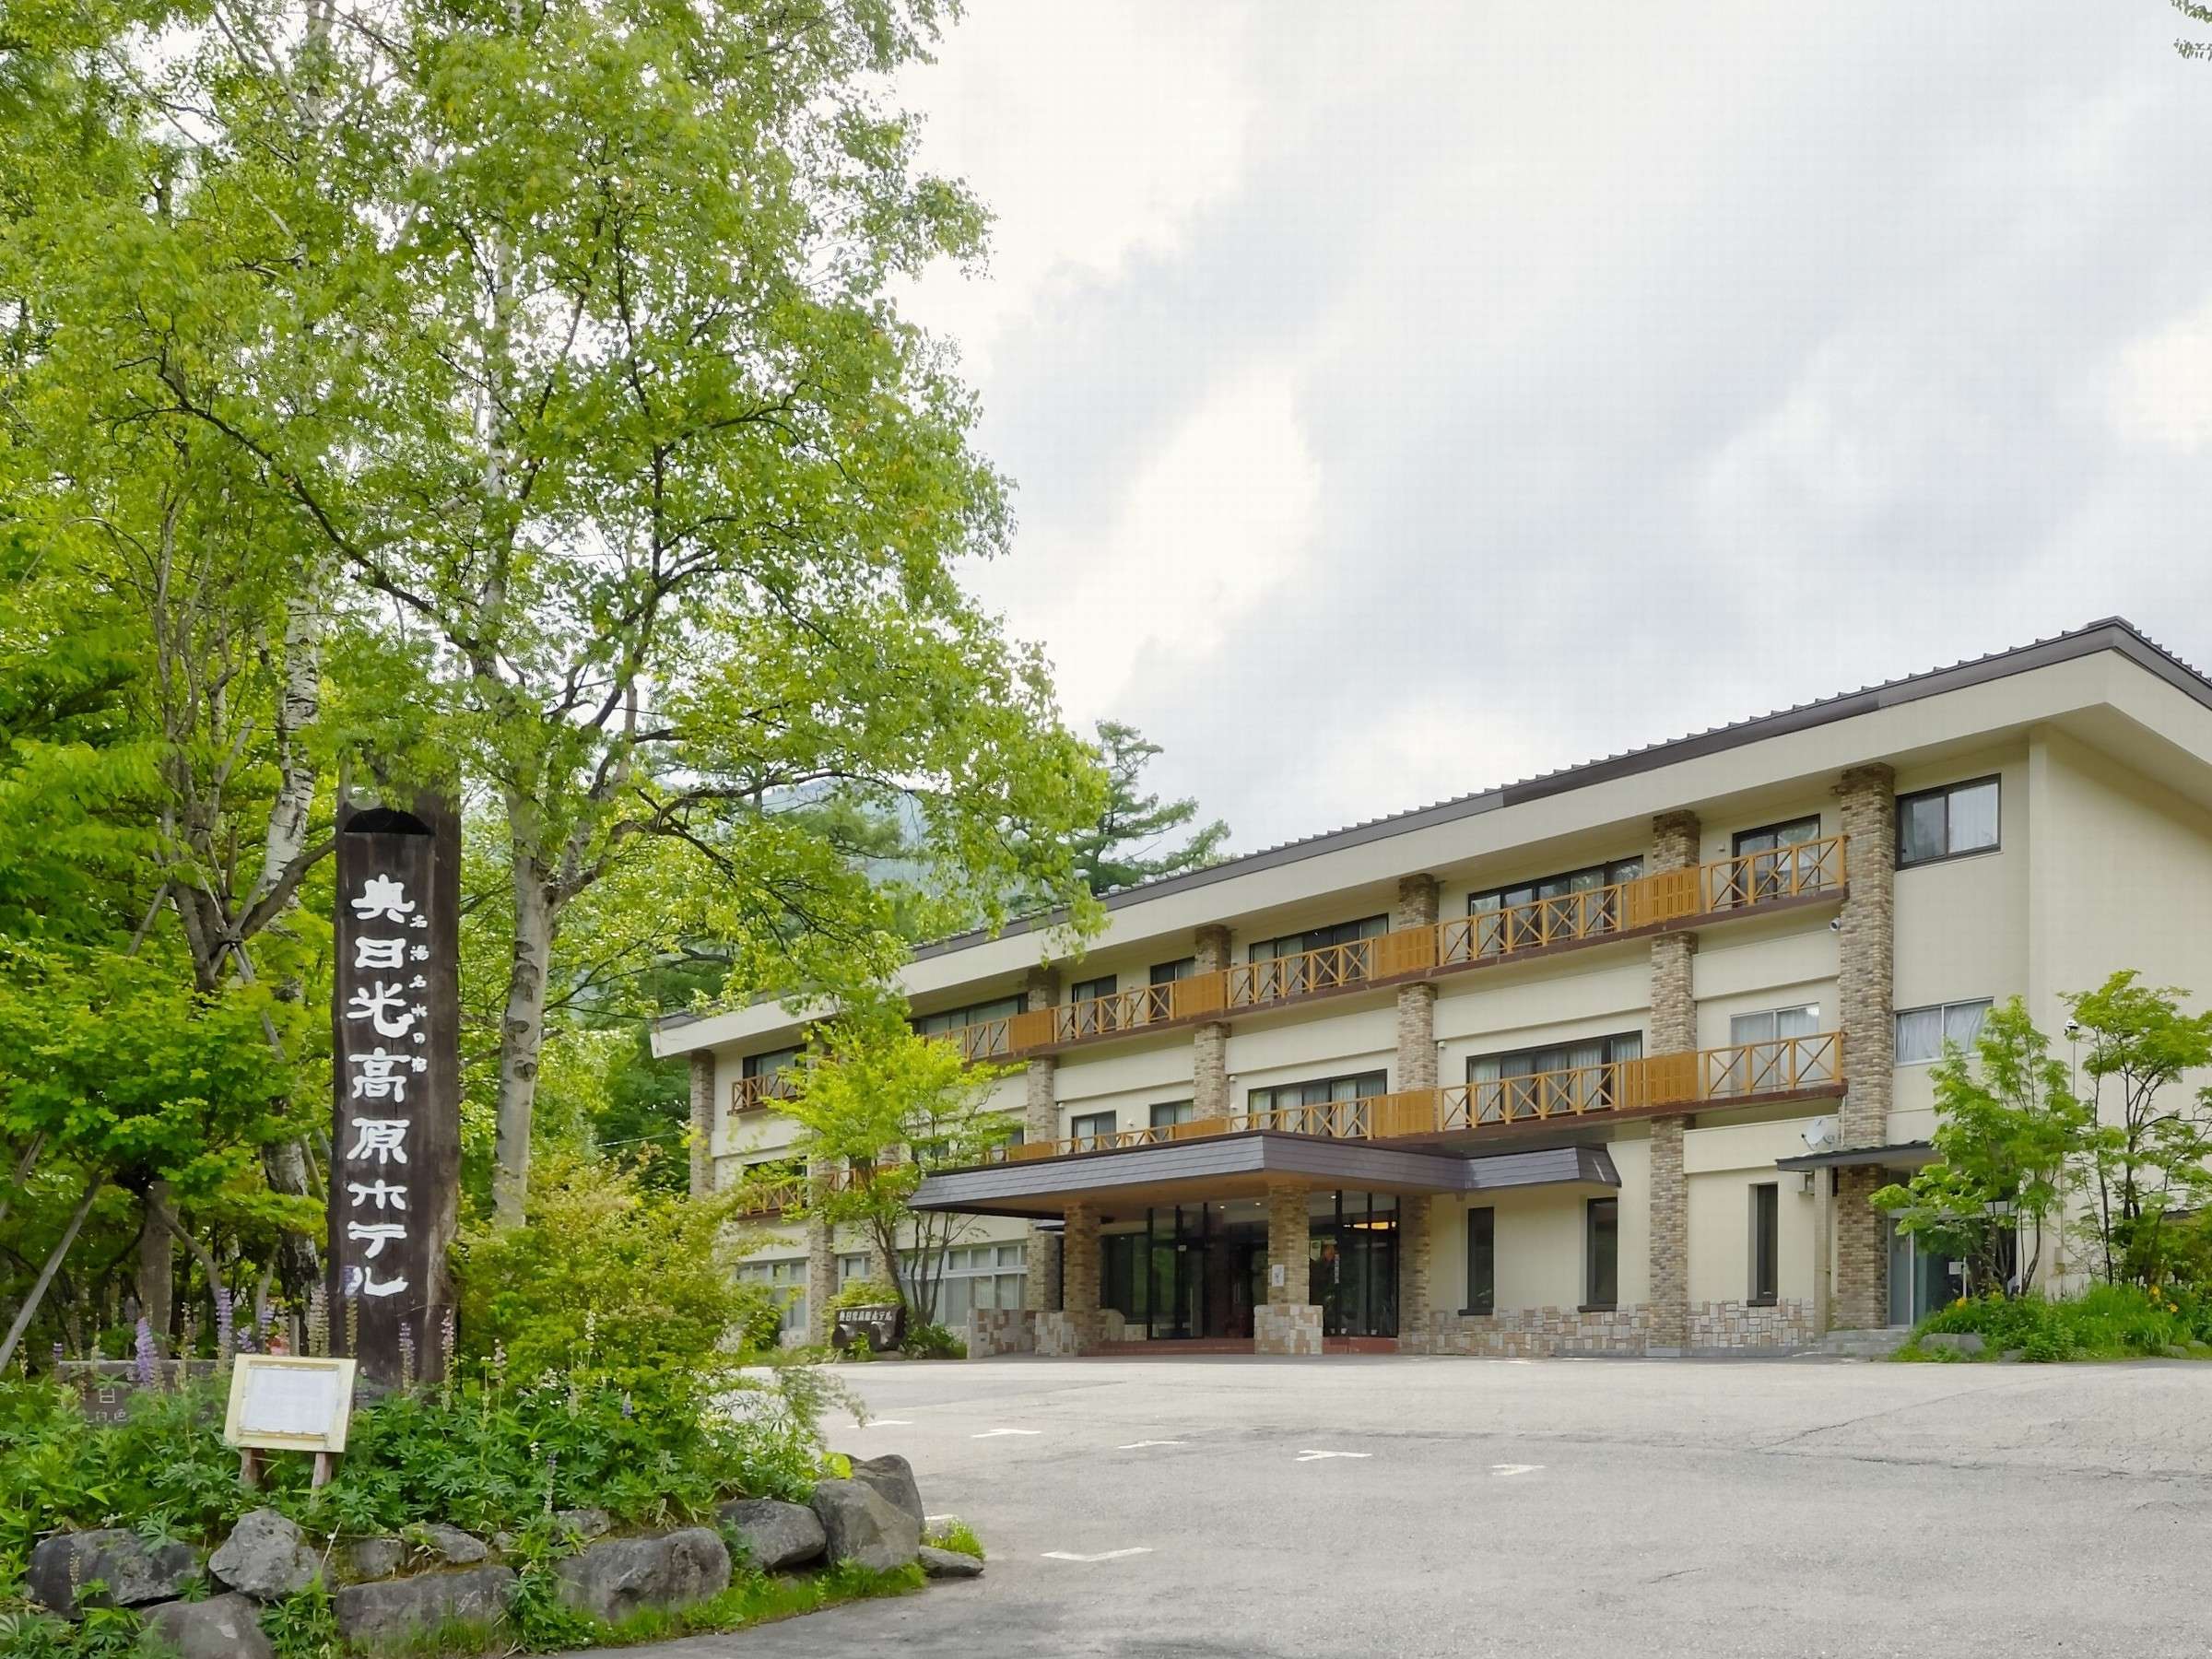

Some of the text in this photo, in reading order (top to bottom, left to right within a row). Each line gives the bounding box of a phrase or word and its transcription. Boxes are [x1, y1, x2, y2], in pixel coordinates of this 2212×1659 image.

[346, 874, 415, 1297] 奥日光高原ホテル
